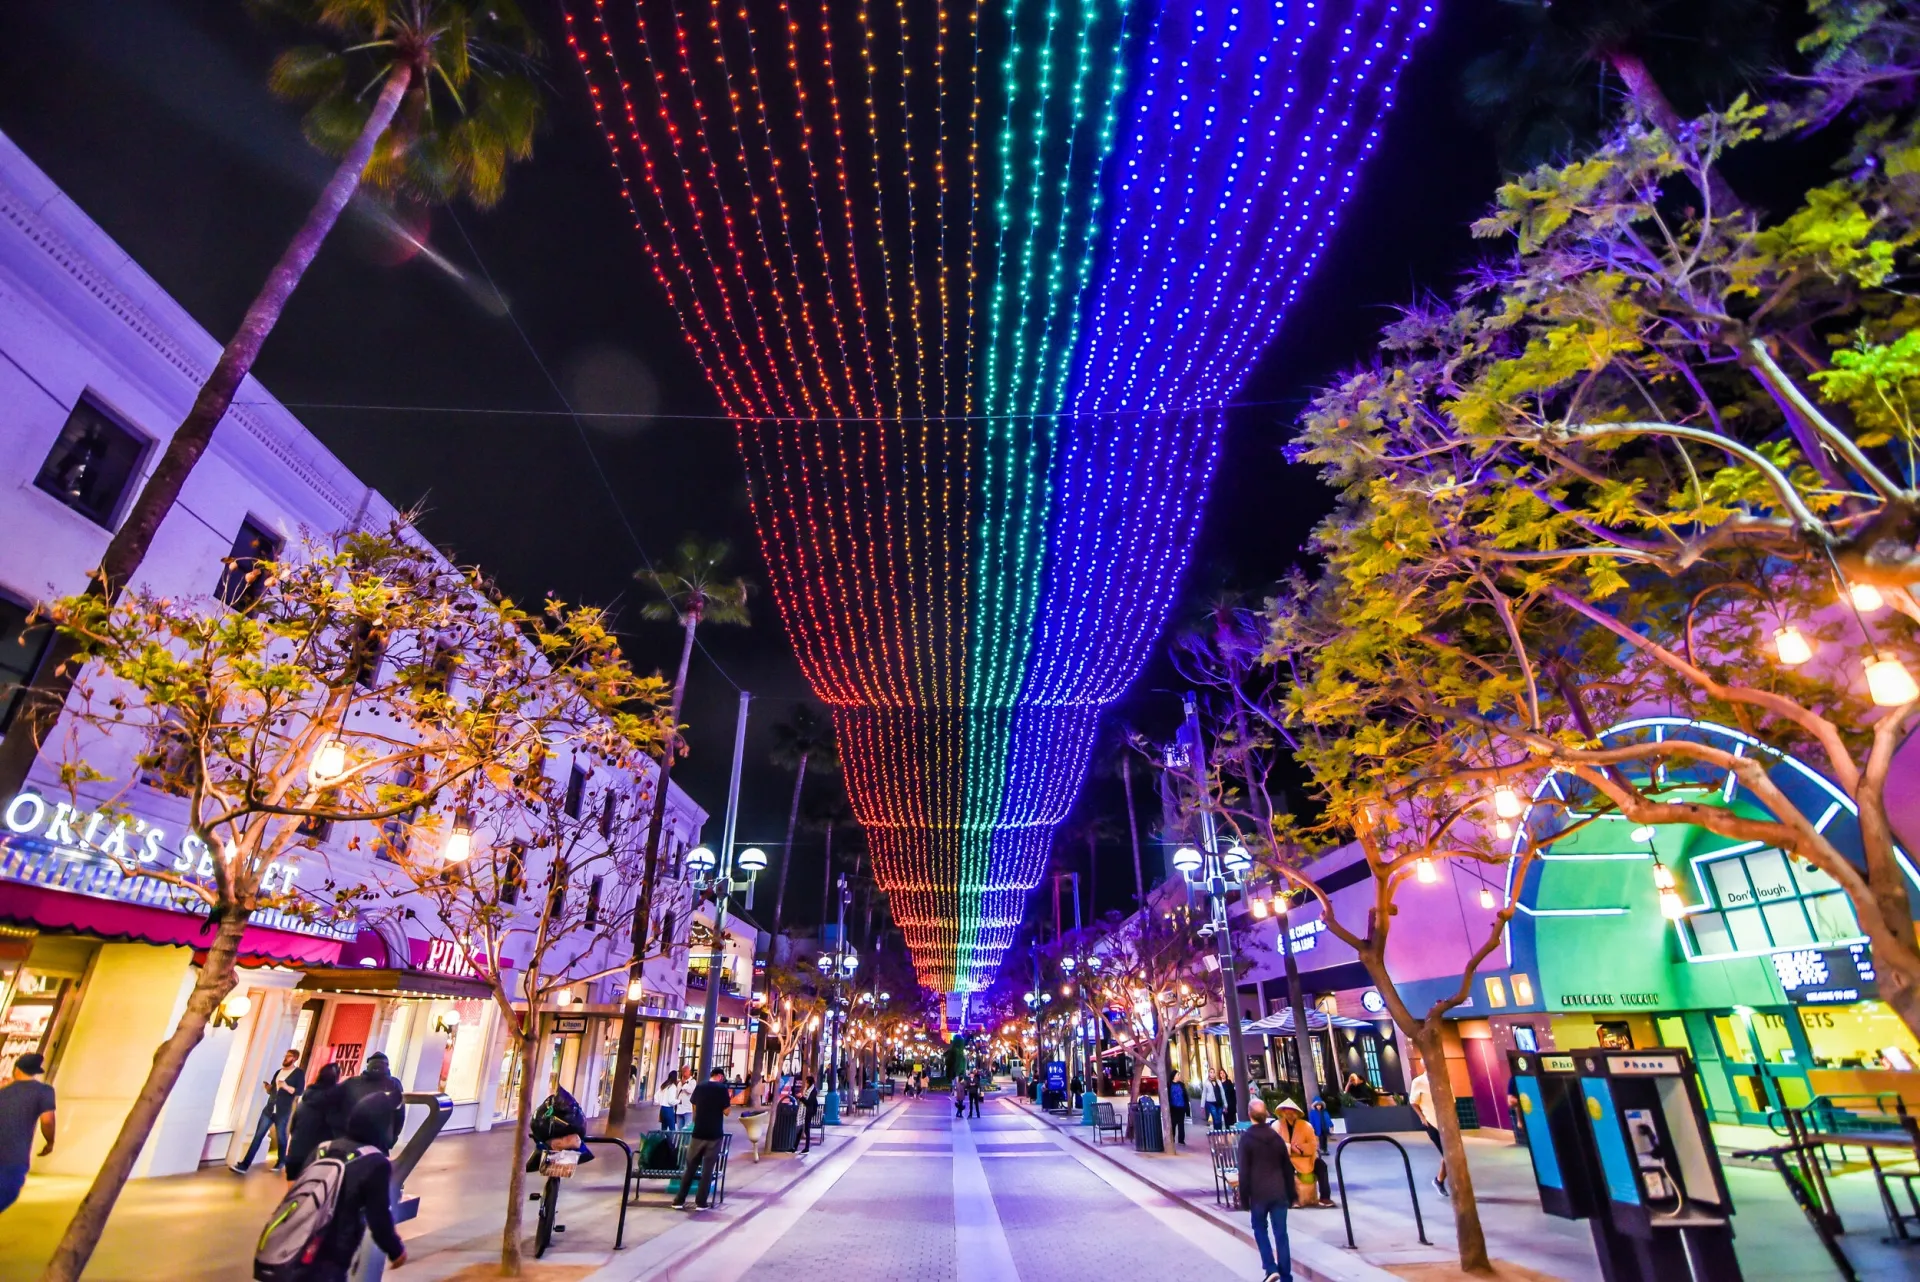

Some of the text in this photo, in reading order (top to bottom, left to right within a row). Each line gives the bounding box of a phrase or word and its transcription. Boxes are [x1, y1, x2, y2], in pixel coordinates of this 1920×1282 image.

[1757, 883, 1790, 898] laugh.
[426, 938, 480, 977] PINK
[1621, 993, 1659, 1006] TICKETS
[331, 1043, 362, 1060] OVE
[1623, 1060, 1664, 1069] Phone
